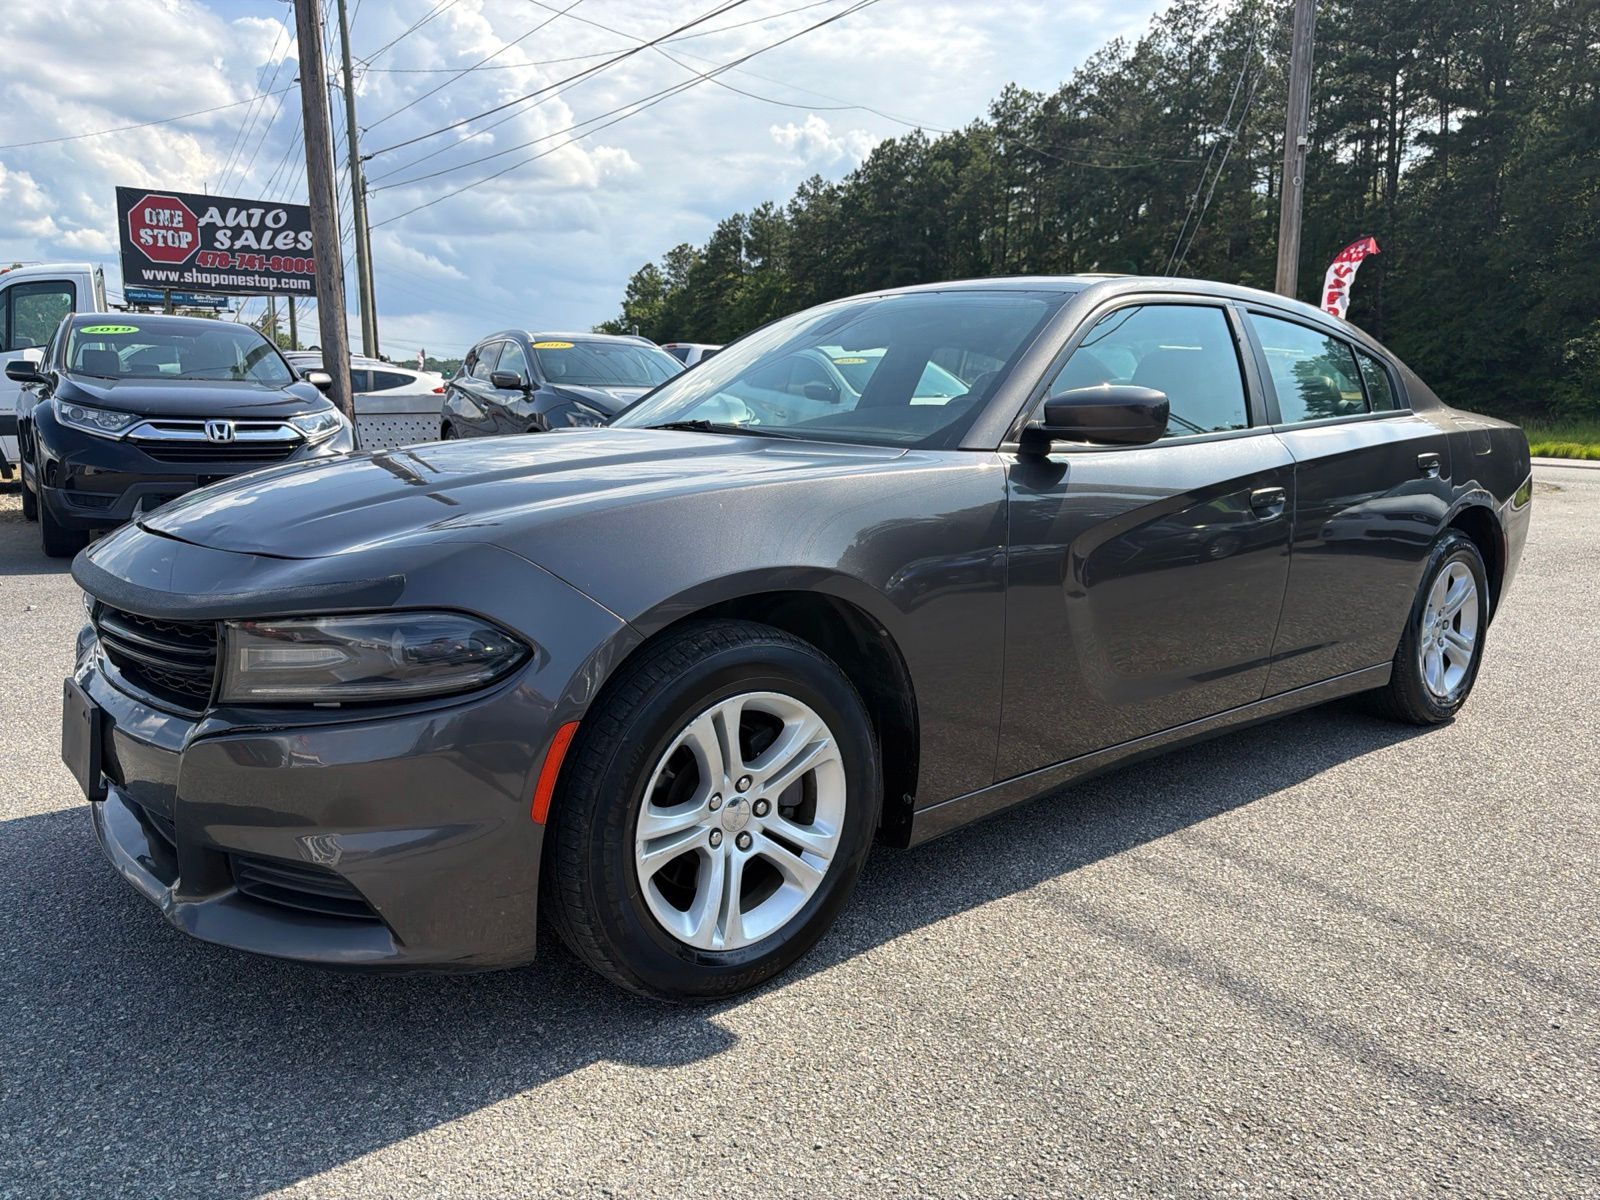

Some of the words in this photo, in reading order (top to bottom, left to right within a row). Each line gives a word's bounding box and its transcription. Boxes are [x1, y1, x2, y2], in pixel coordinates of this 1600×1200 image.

[144, 207, 184, 228] ONE
[197, 206, 288, 229] AUTO
[139, 228, 193, 249] STOP
[141, 267, 311, 290] www.shoponestop.com
